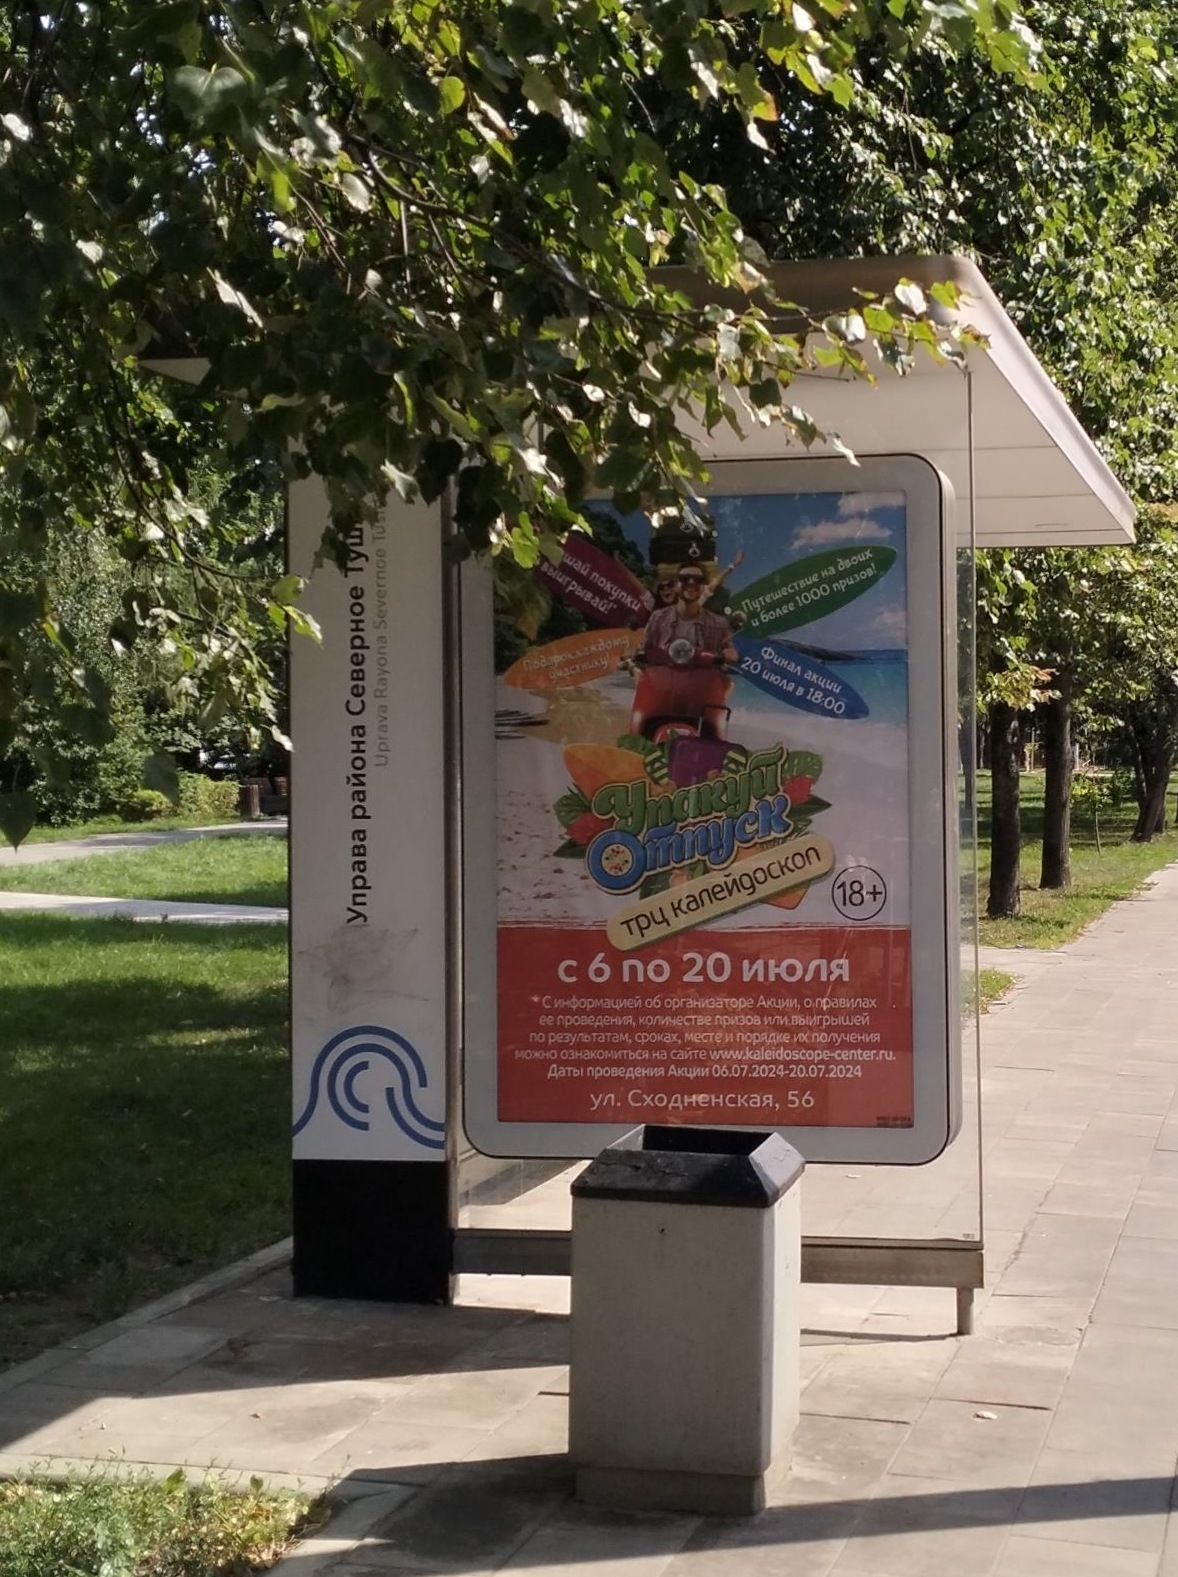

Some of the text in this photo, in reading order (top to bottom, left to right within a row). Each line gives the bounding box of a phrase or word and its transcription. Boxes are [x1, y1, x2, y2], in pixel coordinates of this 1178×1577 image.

[374, 549, 389, 630] Severnoe
[589, 571, 642, 612] покупки
[742, 549, 873, 614] Путешествие на двоих
[751, 563, 878, 627] и более 1000 призов!
[374, 633, 390, 700] Rayona
[740, 656, 846, 715] 20 июля в 18:00
[760, 646, 843, 695] Финал акции
[344, 520, 371, 924] Управа района Северное Туш
[375, 704, 390, 767] Uprava
[593, 746, 787, 834] Упакуй
[585, 795, 792, 896] Отпуск
[837, 879, 884, 907] 18+
[558, 952, 850, 983] с 6 по 20 июля
[539, 1012, 870, 1029] ее проведения, количестве призов или выигрышей
[554, 995, 642, 1013] информацией
[645, 994, 661, 1009] об
[664, 997, 754, 1013] организаторе
[756, 995, 800, 1011] Акции,
[815, 997, 877, 1013] правилах
[515, 1049, 558, 1060] можно
[560, 1049, 649, 1060] ознакомиться
[652, 1049, 667, 1060] на
[670, 1047, 706, 1060] сайте
[529, 1032, 545, 1042] по
[548, 1032, 632, 1046] результатам,
[685, 1032, 722, 1043] месте
[725, 1032, 734, 1042] и
[736, 1032, 790, 1046] порядке
[793, 1032, 809, 1042] их
[812, 1032, 881, 1046] получения
[547, 1063, 584, 1079] Даты
[587, 1065, 665, 1080] проведения
[667, 1064, 709, 1079] Акции
[590, 1089, 815, 1111] ул. Сходненская, 56
